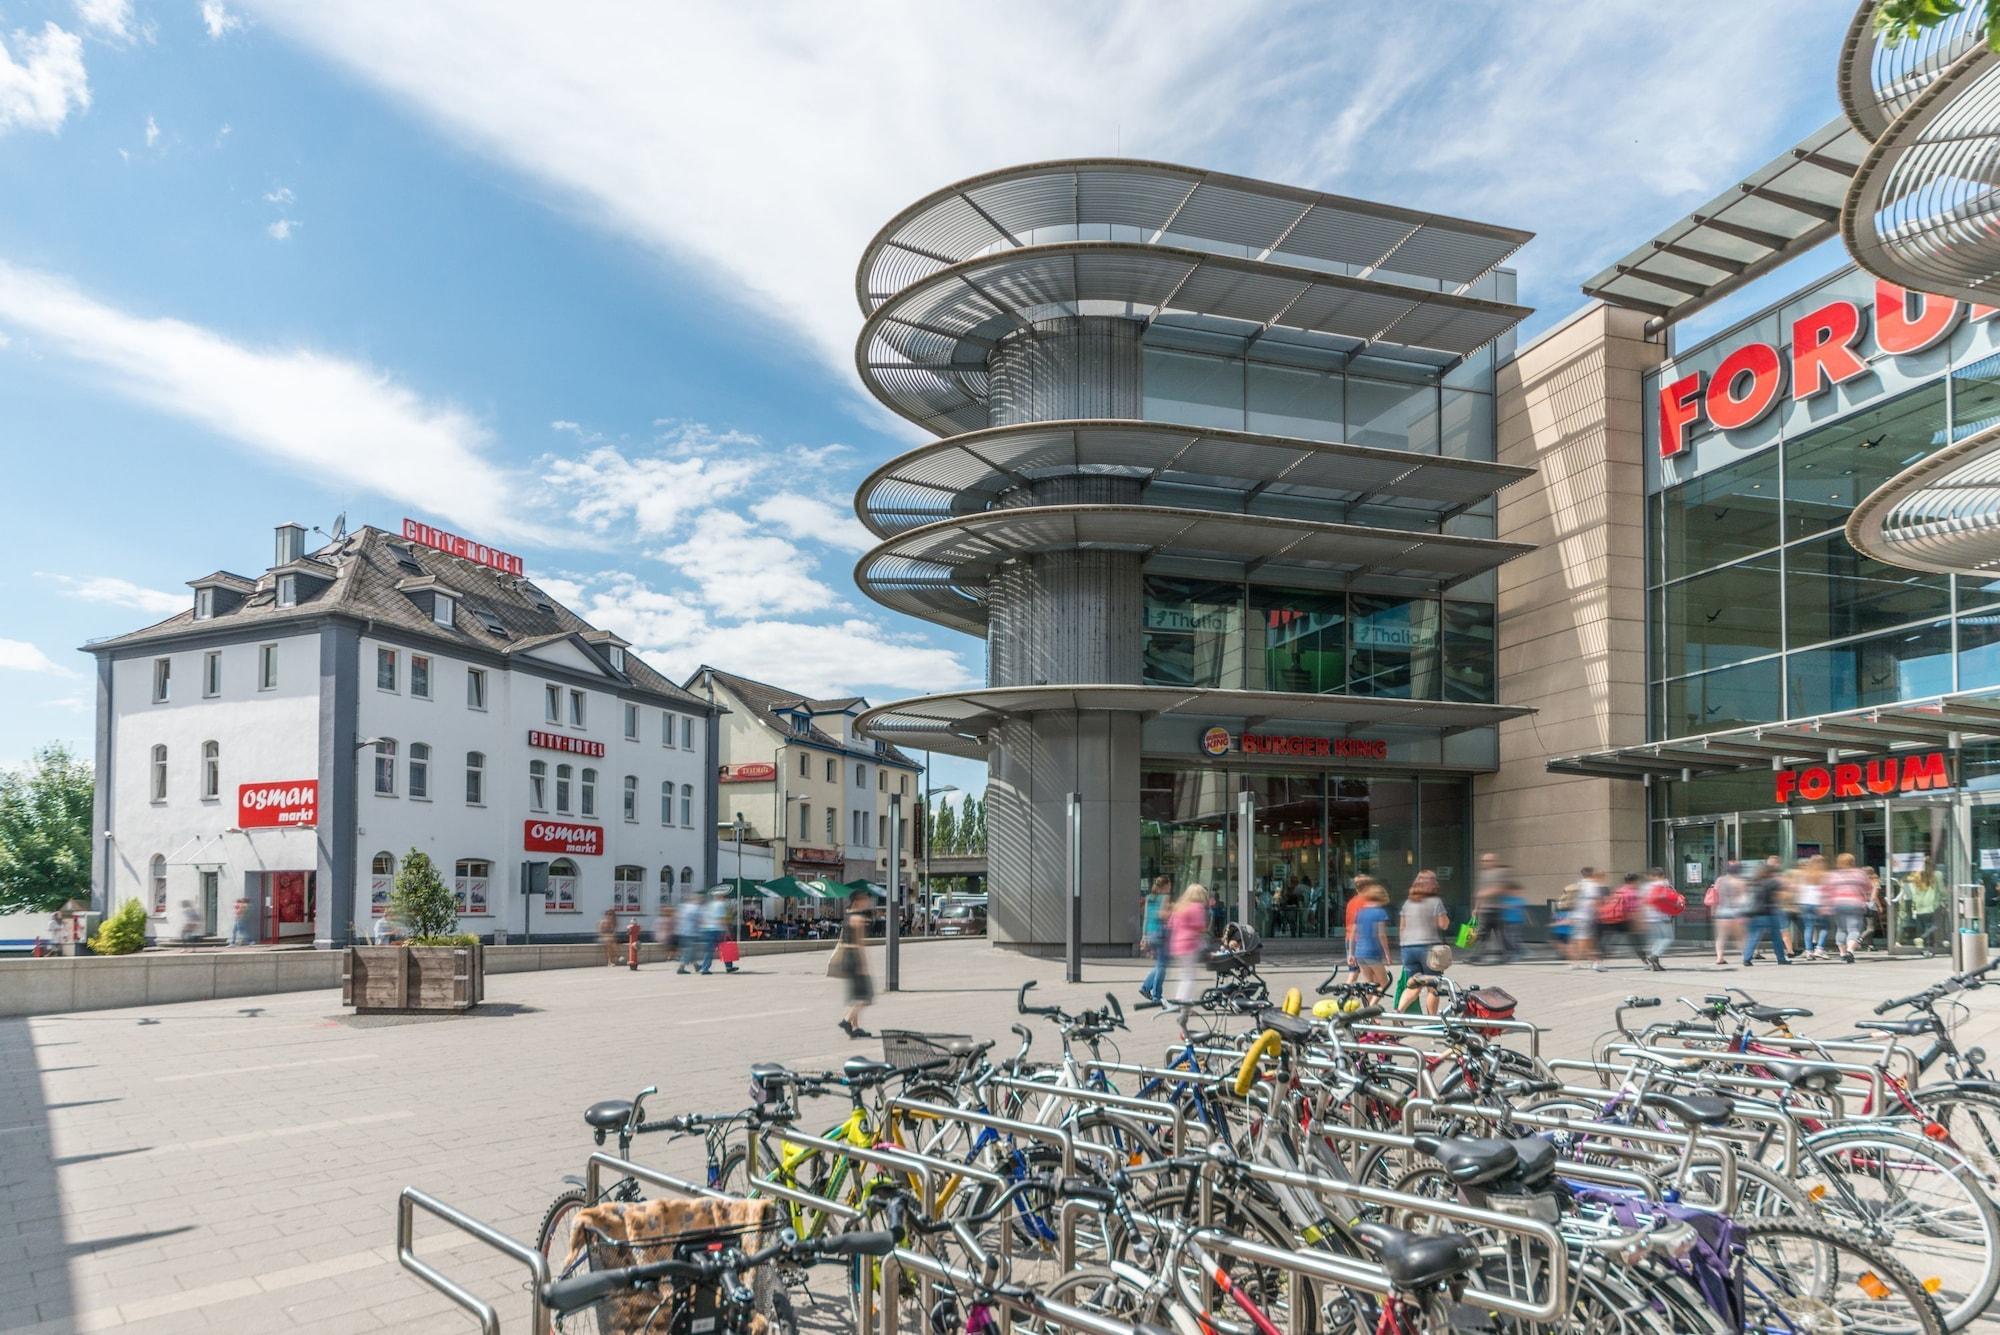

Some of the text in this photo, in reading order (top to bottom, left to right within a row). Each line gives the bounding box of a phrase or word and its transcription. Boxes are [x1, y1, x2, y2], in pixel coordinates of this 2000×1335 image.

[1658, 277, 2000, 458] FORU
[403, 519, 523, 576] CITY-HOTEL
[529, 731, 604, 757] CITY-HOTEL
[1204, 738, 1228, 749] KING
[1241, 733, 1388, 761] BURGER KING
[1775, 752, 1949, 804] FORUM
[278, 807, 314, 822] markt
[565, 843, 596, 854] markt
